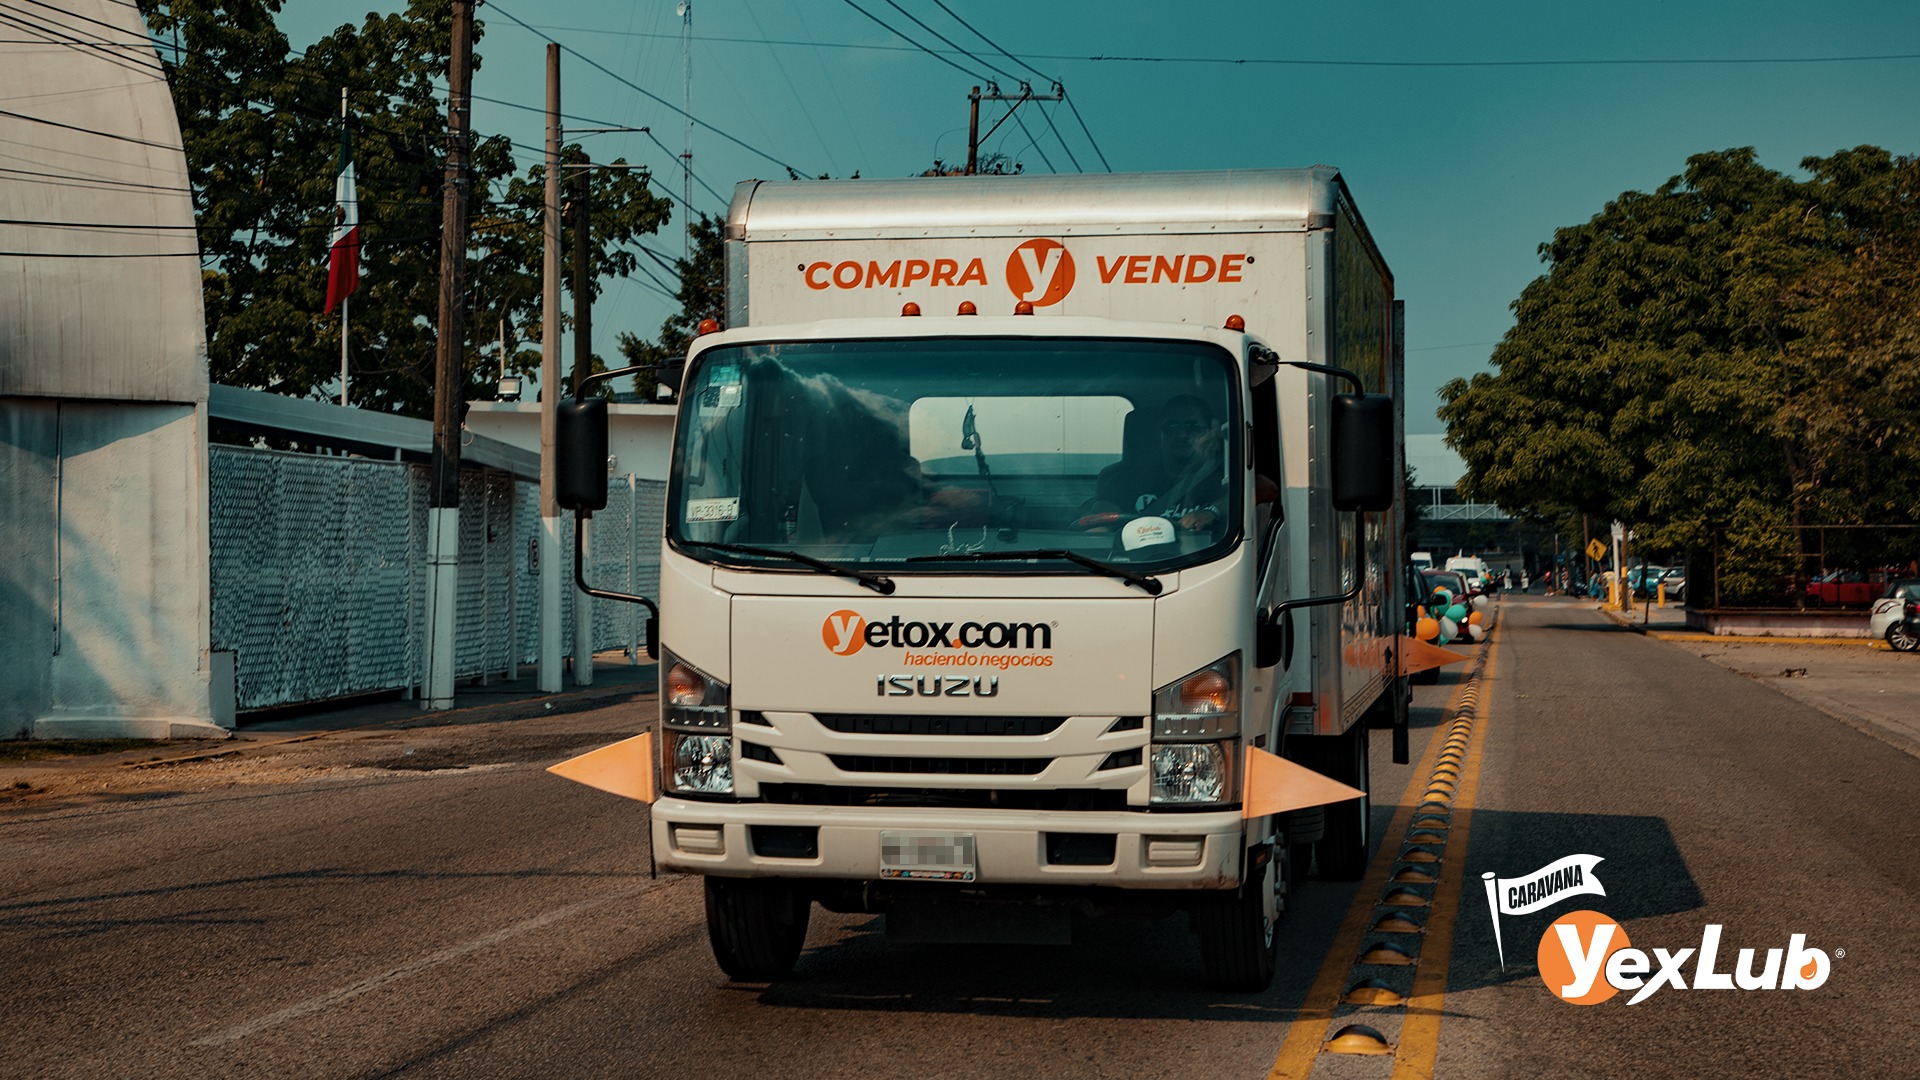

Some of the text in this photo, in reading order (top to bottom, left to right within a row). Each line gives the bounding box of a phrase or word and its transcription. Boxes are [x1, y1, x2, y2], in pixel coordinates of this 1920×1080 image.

[804, 257, 988, 291] COMPRA
[1096, 253, 1246, 285] VENDE
[903, 651, 1054, 671] haciendo negocios
[877, 673, 999, 698] ISUZU
